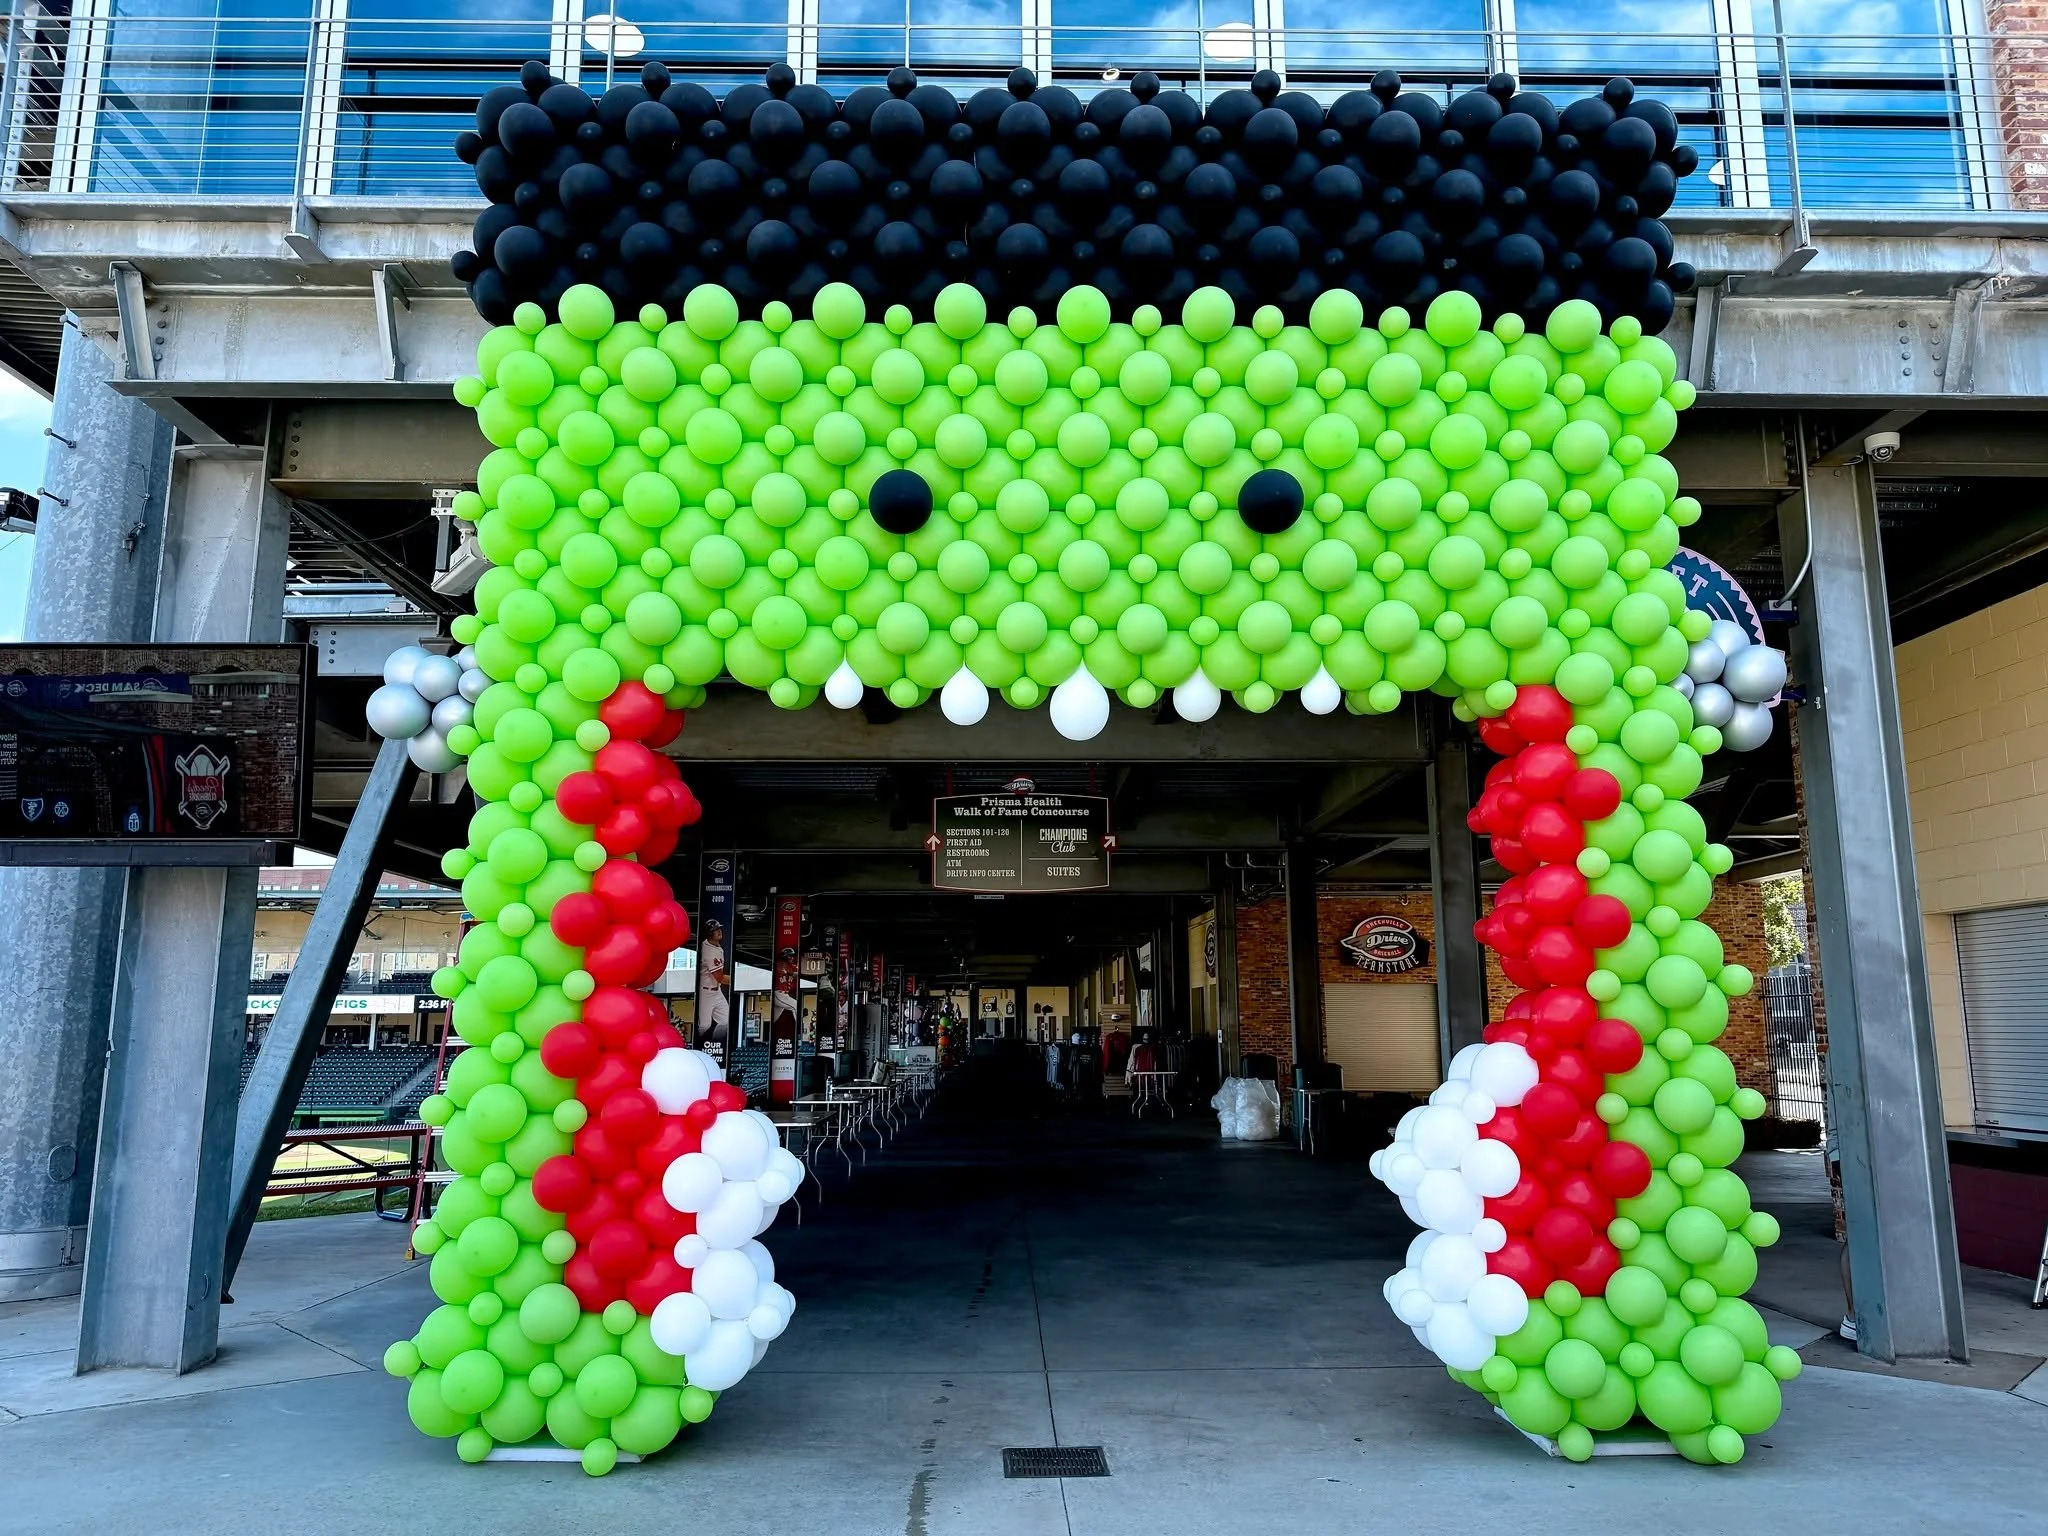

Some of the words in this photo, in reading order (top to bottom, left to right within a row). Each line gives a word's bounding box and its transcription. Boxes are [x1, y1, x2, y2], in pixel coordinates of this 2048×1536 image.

[981, 798, 1021, 806] Prisma
[1024, 798, 1062, 806] Health
[954, 807, 982, 816] Walk
[984, 807, 996, 816] of
[998, 808, 1028, 816] Fame
[1031, 807, 1089, 816] Concourse
[1040, 829, 1087, 841] CHAMPIONS
[1051, 841, 1075, 853] Club
[946, 849, 990, 857] RESTROOMS
[1047, 867, 1080, 876] SUITES
[1365, 920, 1404, 929] GREENVILLE
[1366, 933, 1409, 947] Drive
[806, 960, 821, 971] 101
[419, 1000, 440, 1009] 2:36
[704, 1041, 722, 1049] OUR
